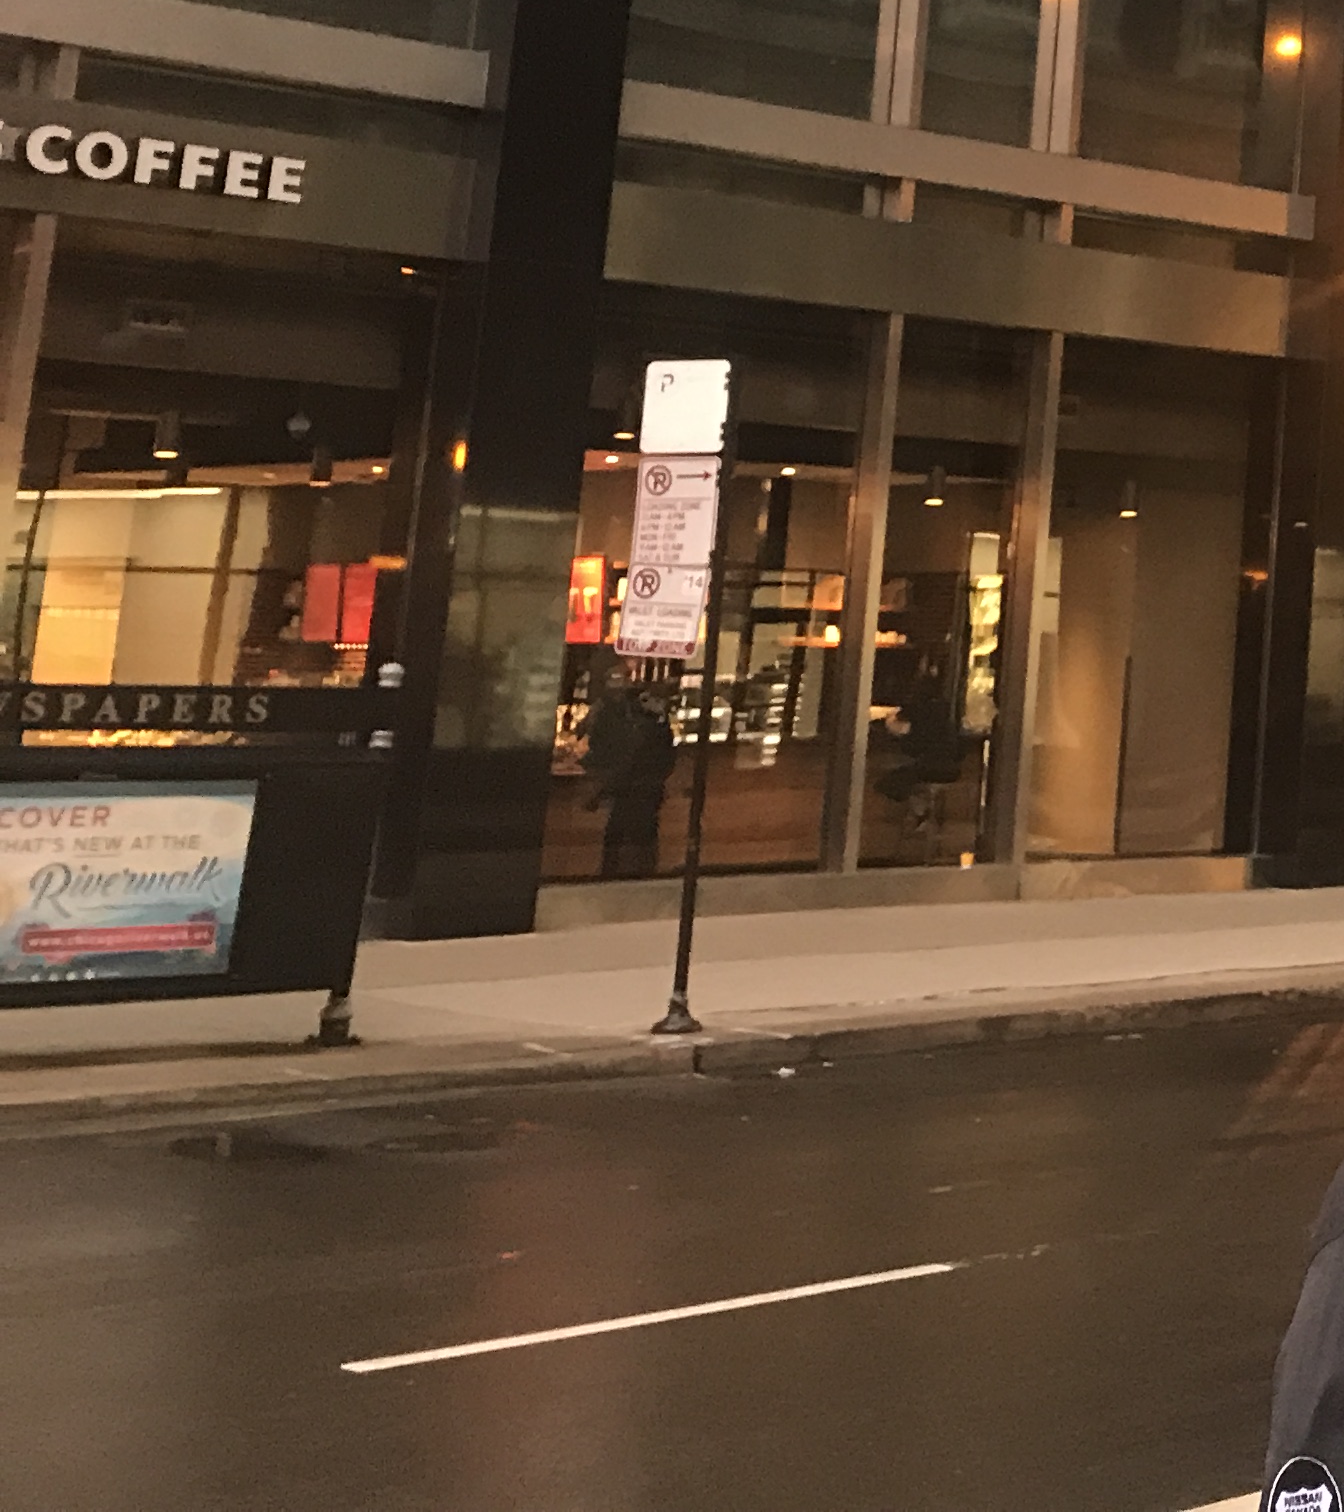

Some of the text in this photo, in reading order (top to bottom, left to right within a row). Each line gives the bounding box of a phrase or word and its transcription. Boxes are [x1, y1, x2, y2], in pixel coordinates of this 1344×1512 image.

[25, 123, 307, 204] COFFEE
[0, 834, 201, 854] HAT'S NEW AT THE
[29, 855, 224, 919] Riverwalk
[1284, 1491, 1323, 1508] NISSAN
